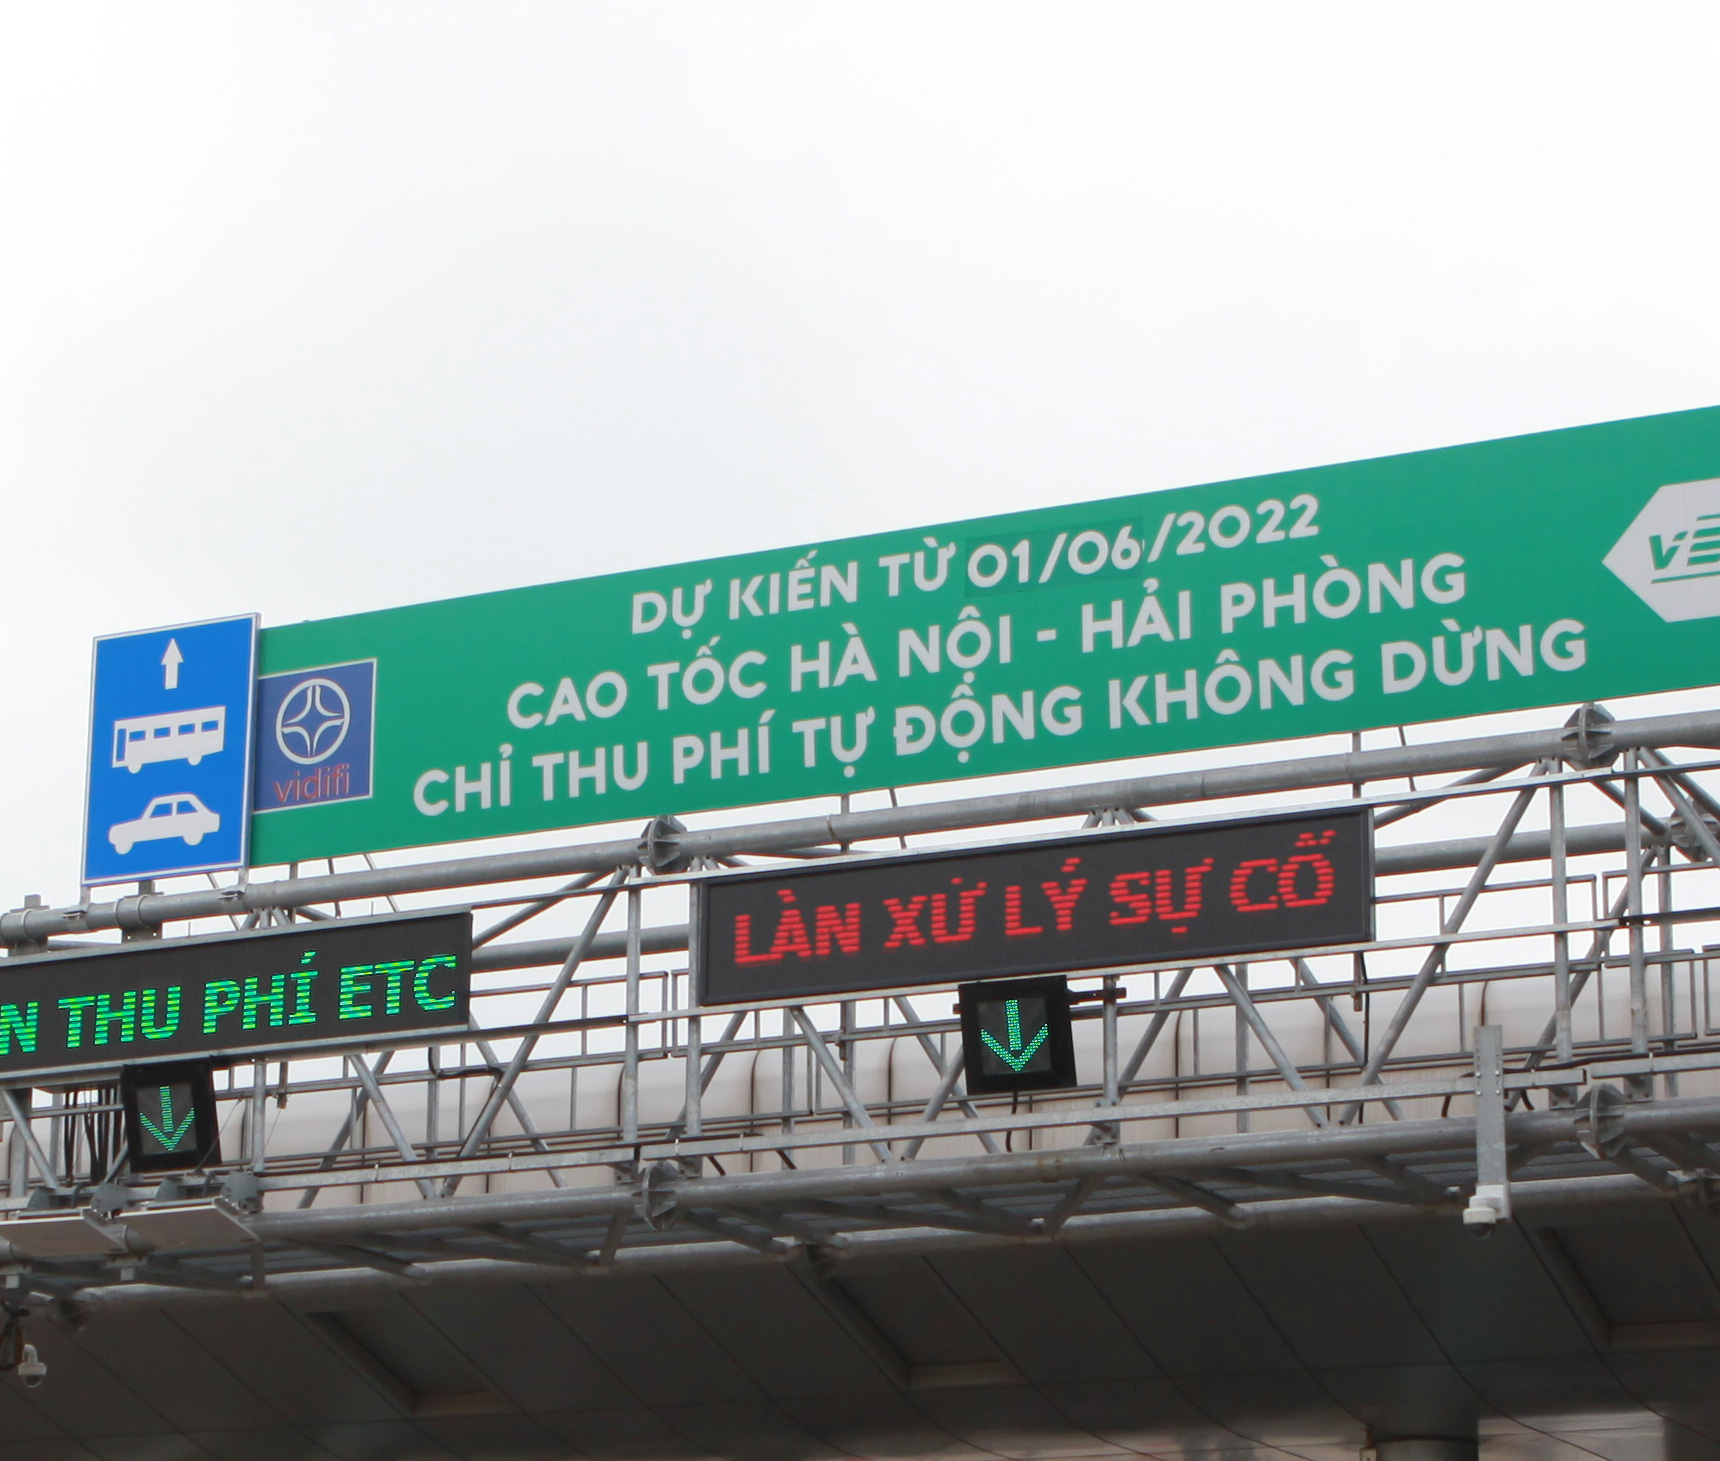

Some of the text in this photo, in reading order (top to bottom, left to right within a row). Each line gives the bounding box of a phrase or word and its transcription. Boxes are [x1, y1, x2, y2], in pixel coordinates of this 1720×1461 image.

[631, 494, 1320, 639] DỰ KIẾN TỪ 01/06/2022
[507, 553, 1467, 729] CAO TỐC HÀ NỘI HẢI PHÒNG
[413, 618, 1587, 817] CHỈ THU PHÍ TỰ ĐỘNG KHÔNG DỪNG
[273, 763, 351, 803] vidifi
[734, 888, 862, 965] LÀN
[883, 877, 988, 948] XỬ
[1004, 857, 1088, 936] LÝ
[1109, 857, 1215, 935] SỰ
[58, 985, 181, 1048] THU
[202, 950, 318, 1035] PHÍ
[339, 953, 456, 1022] ETC
